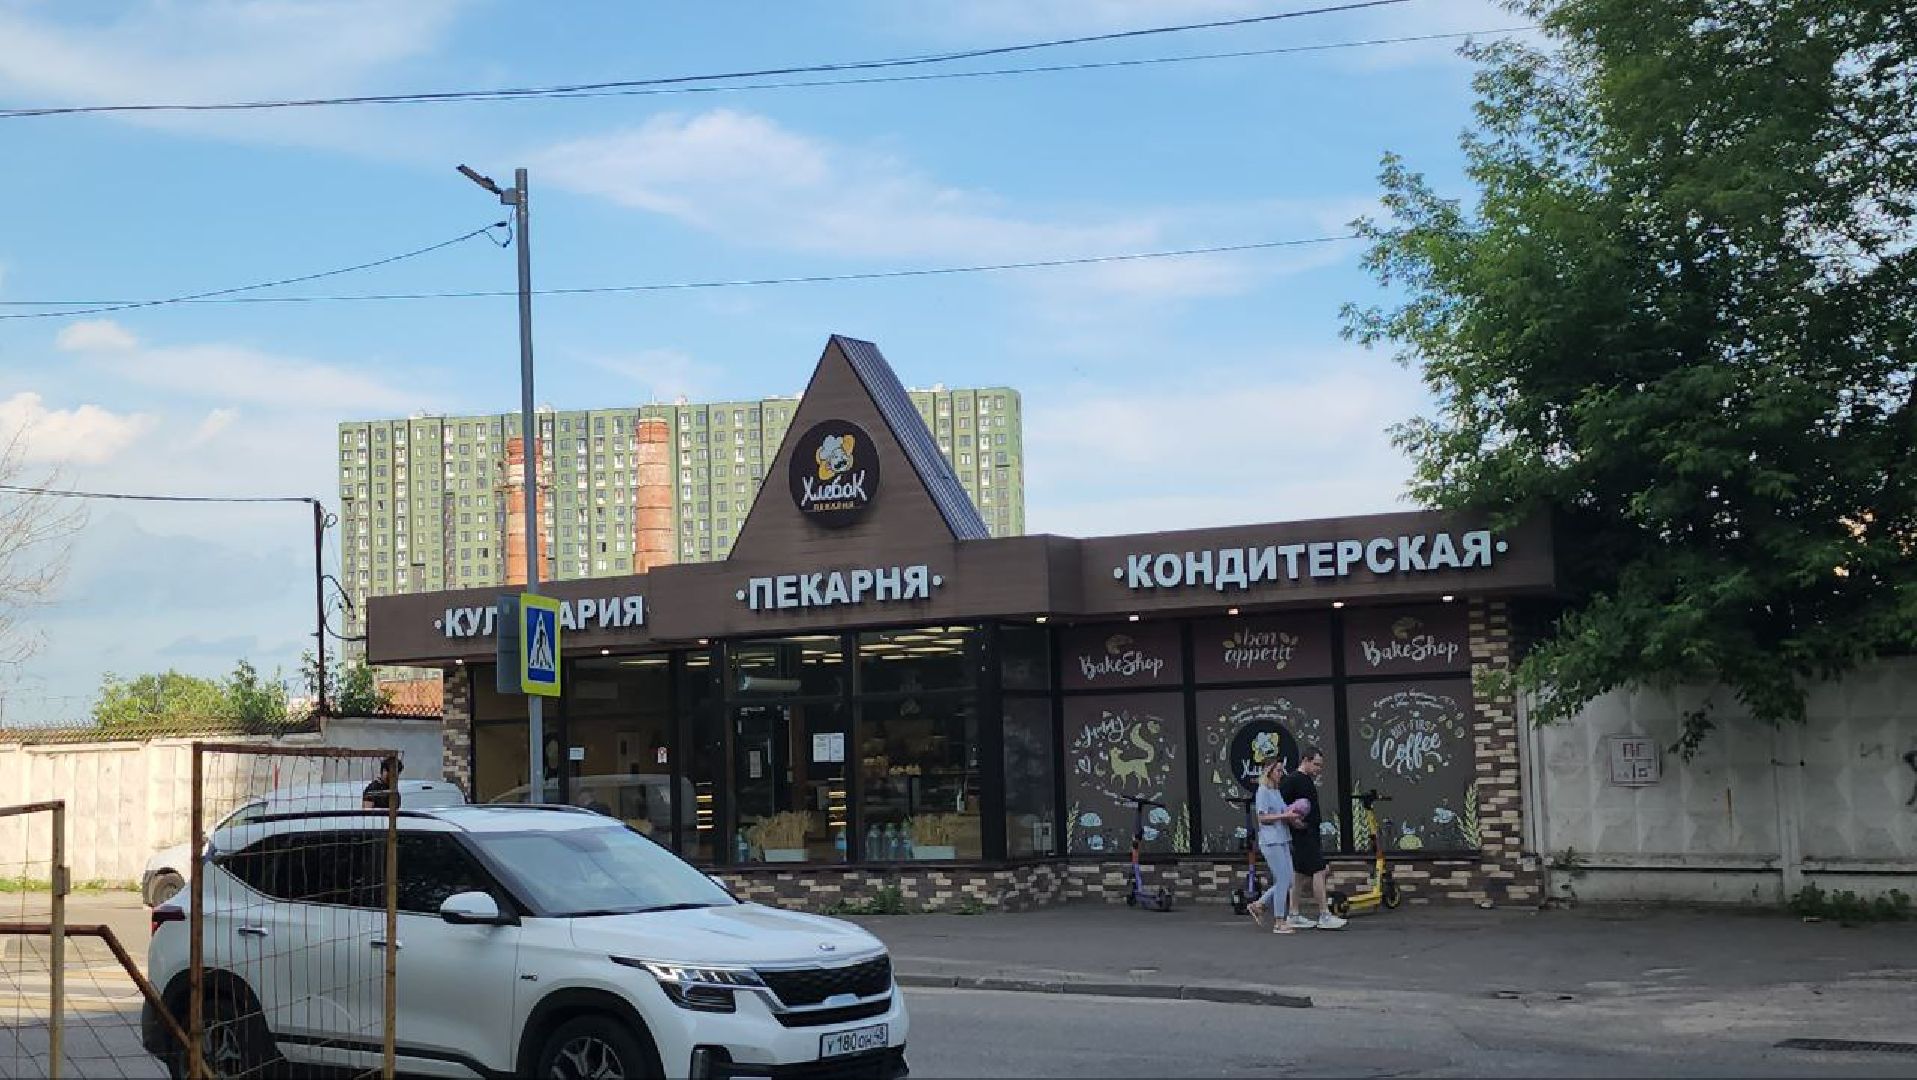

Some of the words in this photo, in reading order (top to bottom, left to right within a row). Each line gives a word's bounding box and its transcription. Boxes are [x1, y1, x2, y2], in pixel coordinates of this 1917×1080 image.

[1127, 530, 1493, 592] КОНДИТЕРСКАЯ
[749, 564, 930, 611] ПЕКАРНЯ
[444, 595, 644, 638] КУЛАРИЯ
[1361, 634, 1459, 667] BakeShop
